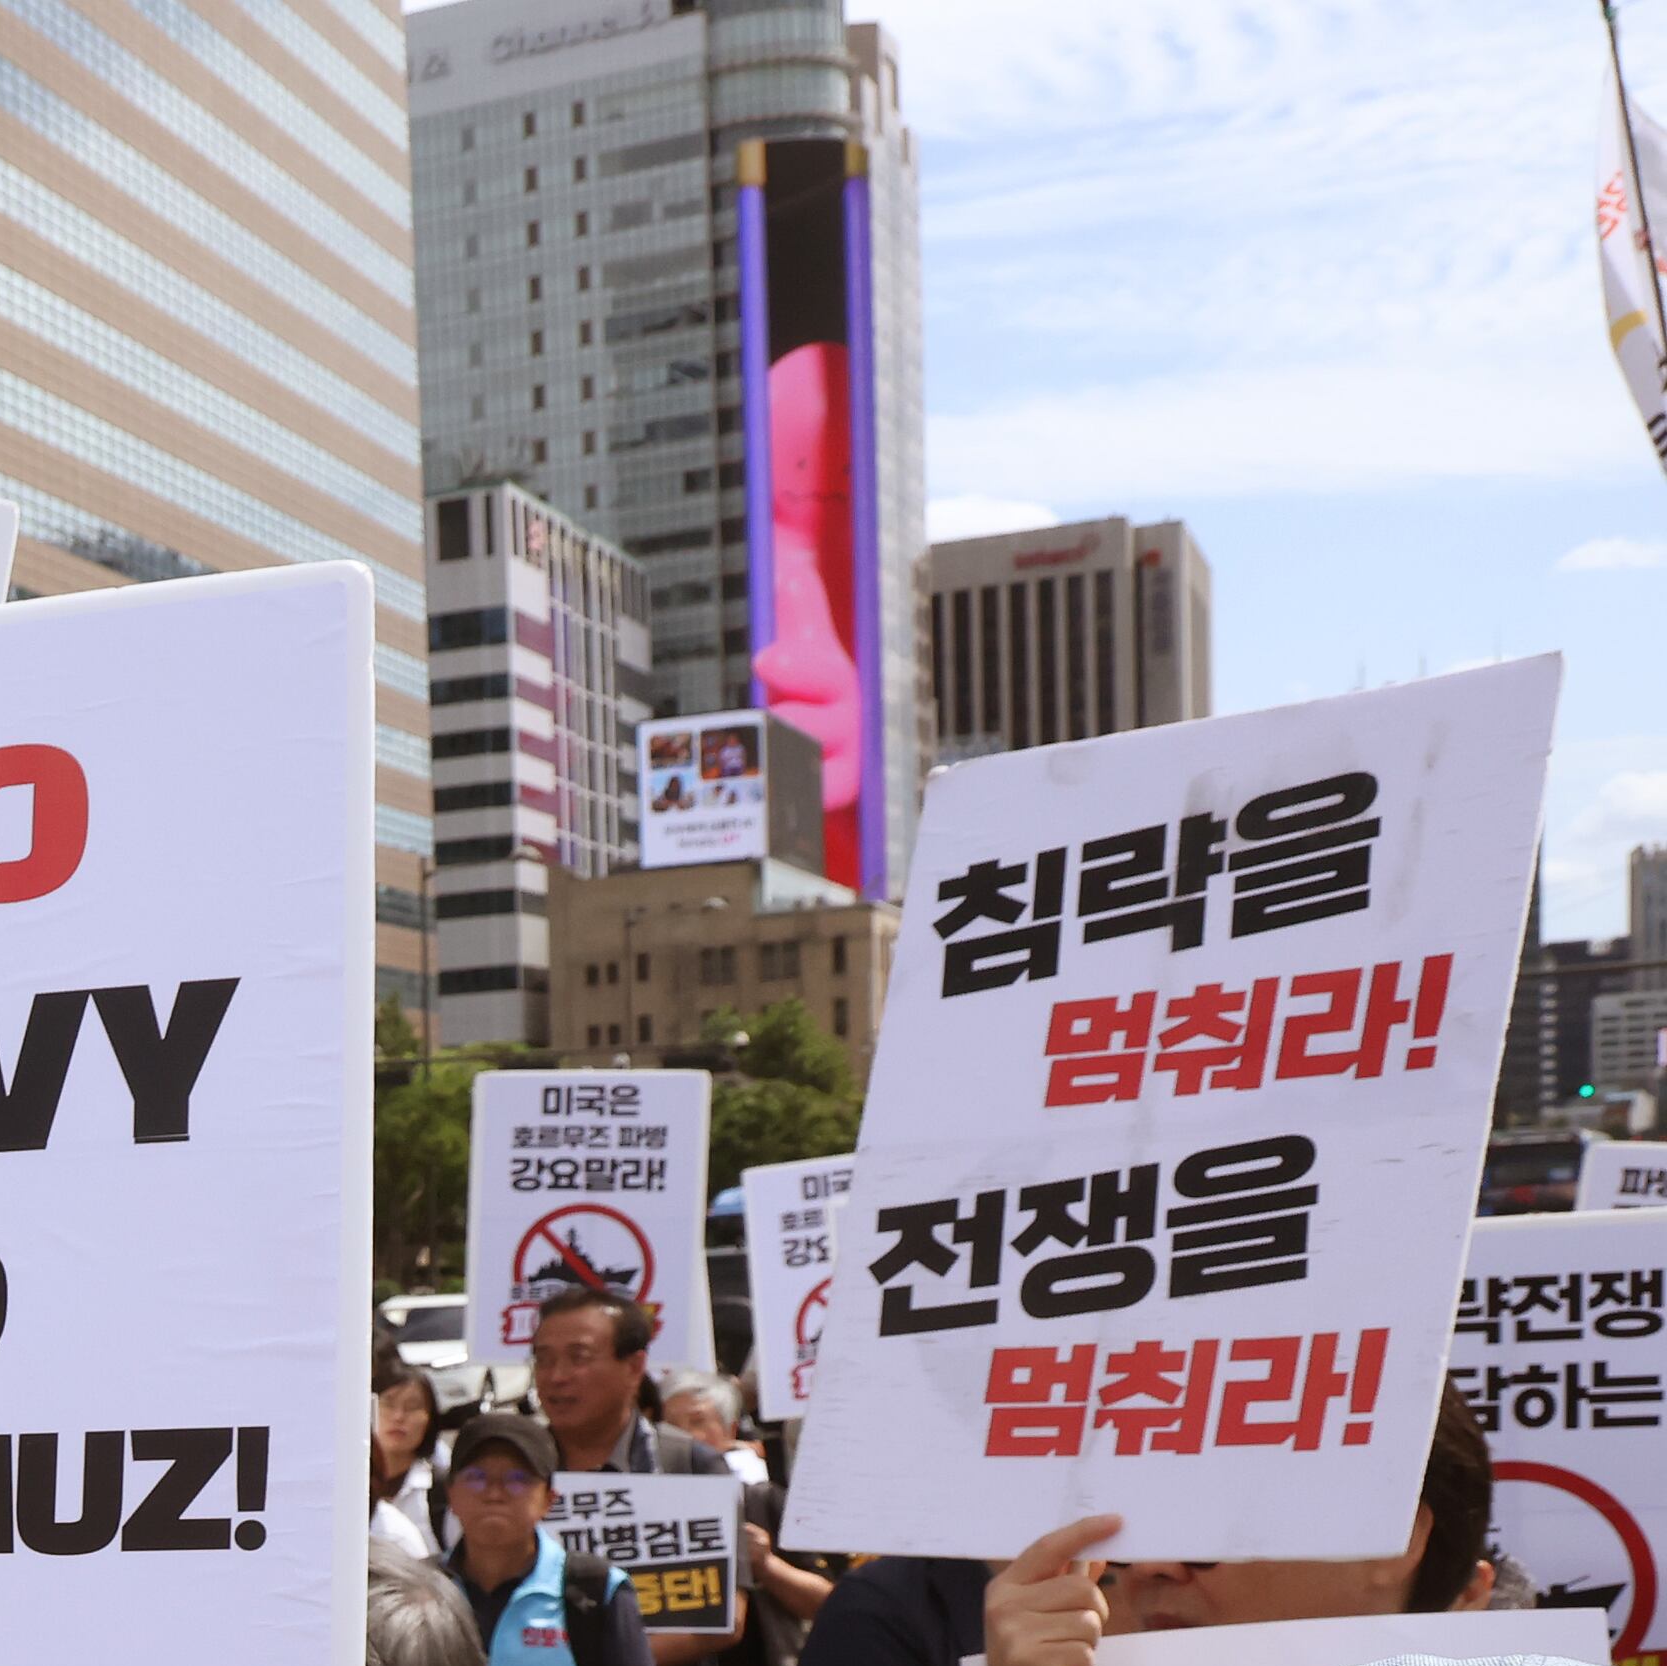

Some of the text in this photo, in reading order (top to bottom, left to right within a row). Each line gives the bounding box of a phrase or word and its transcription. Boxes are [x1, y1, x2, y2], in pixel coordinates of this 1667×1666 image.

[933, 771, 1379, 999] 침략을
[543, 1085, 640, 1116] 미국은
[1044, 954, 1455, 1107] 멈춰라!
[511, 1158, 667, 1191] 강요말라!
[868, 1134, 1318, 1337] 전쟁을
[984, 1327, 1390, 1458] 멈춰라!
